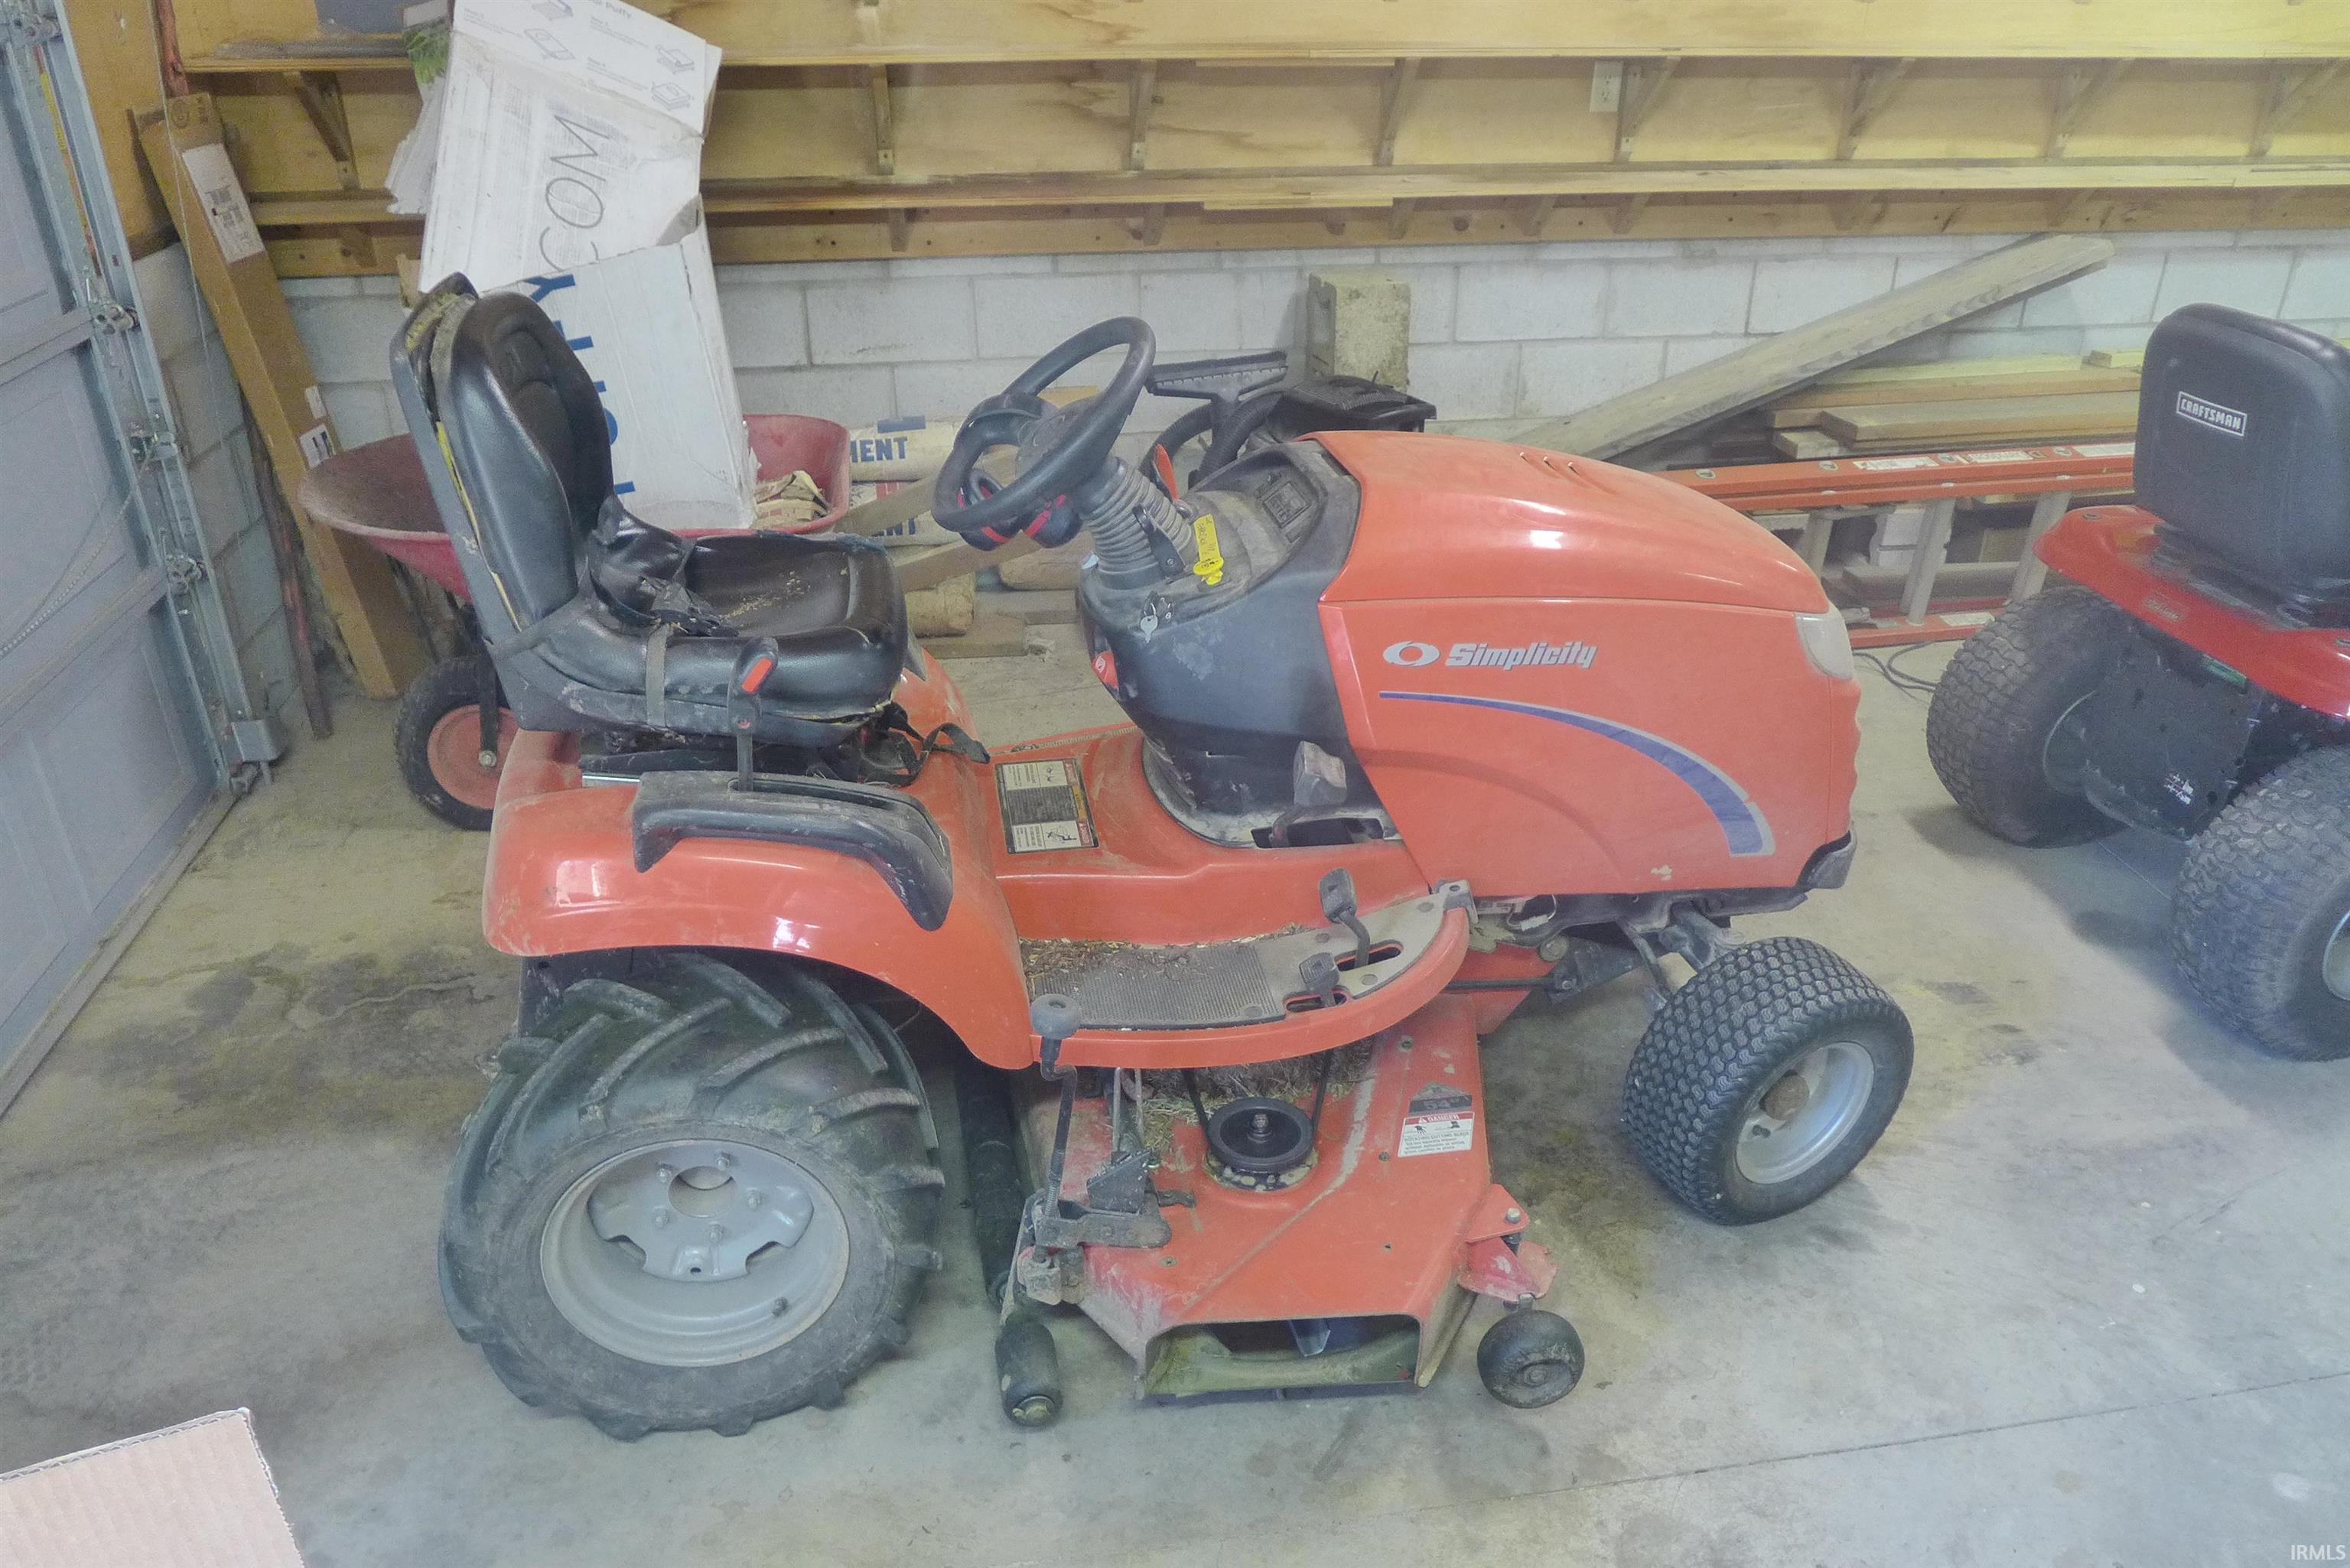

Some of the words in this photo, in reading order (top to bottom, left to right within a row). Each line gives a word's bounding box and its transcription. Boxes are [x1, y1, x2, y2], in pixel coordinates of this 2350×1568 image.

[2181, 399, 2241, 429] CRAFTSMAN
[1445, 640, 1598, 672] Simplicity
[1427, 1114, 1460, 1122] DANGER
